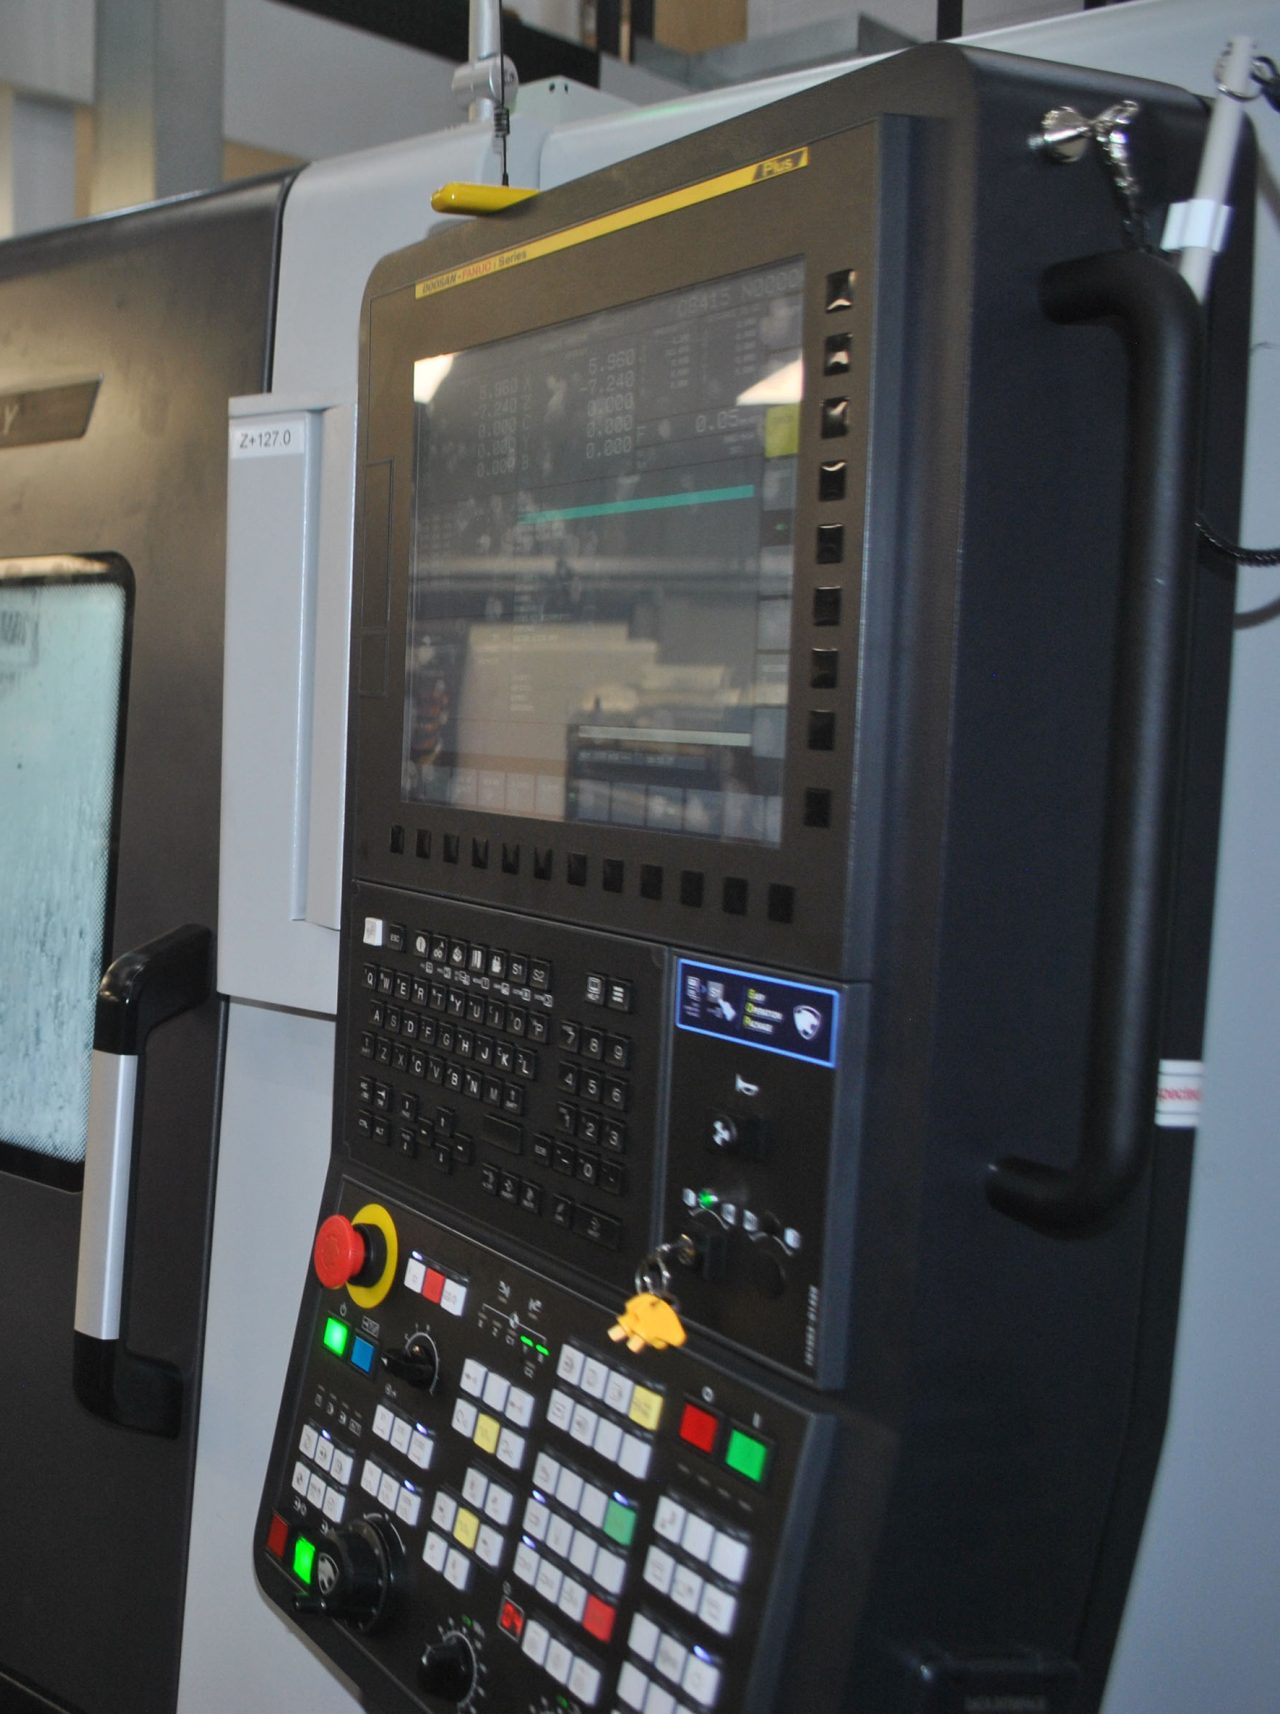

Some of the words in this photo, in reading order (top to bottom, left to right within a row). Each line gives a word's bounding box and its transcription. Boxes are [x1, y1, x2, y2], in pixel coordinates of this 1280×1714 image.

[762, 157, 794, 178] Plus
[498, 250, 528, 268] Series
[240, 428, 291, 448] Z+127.0
